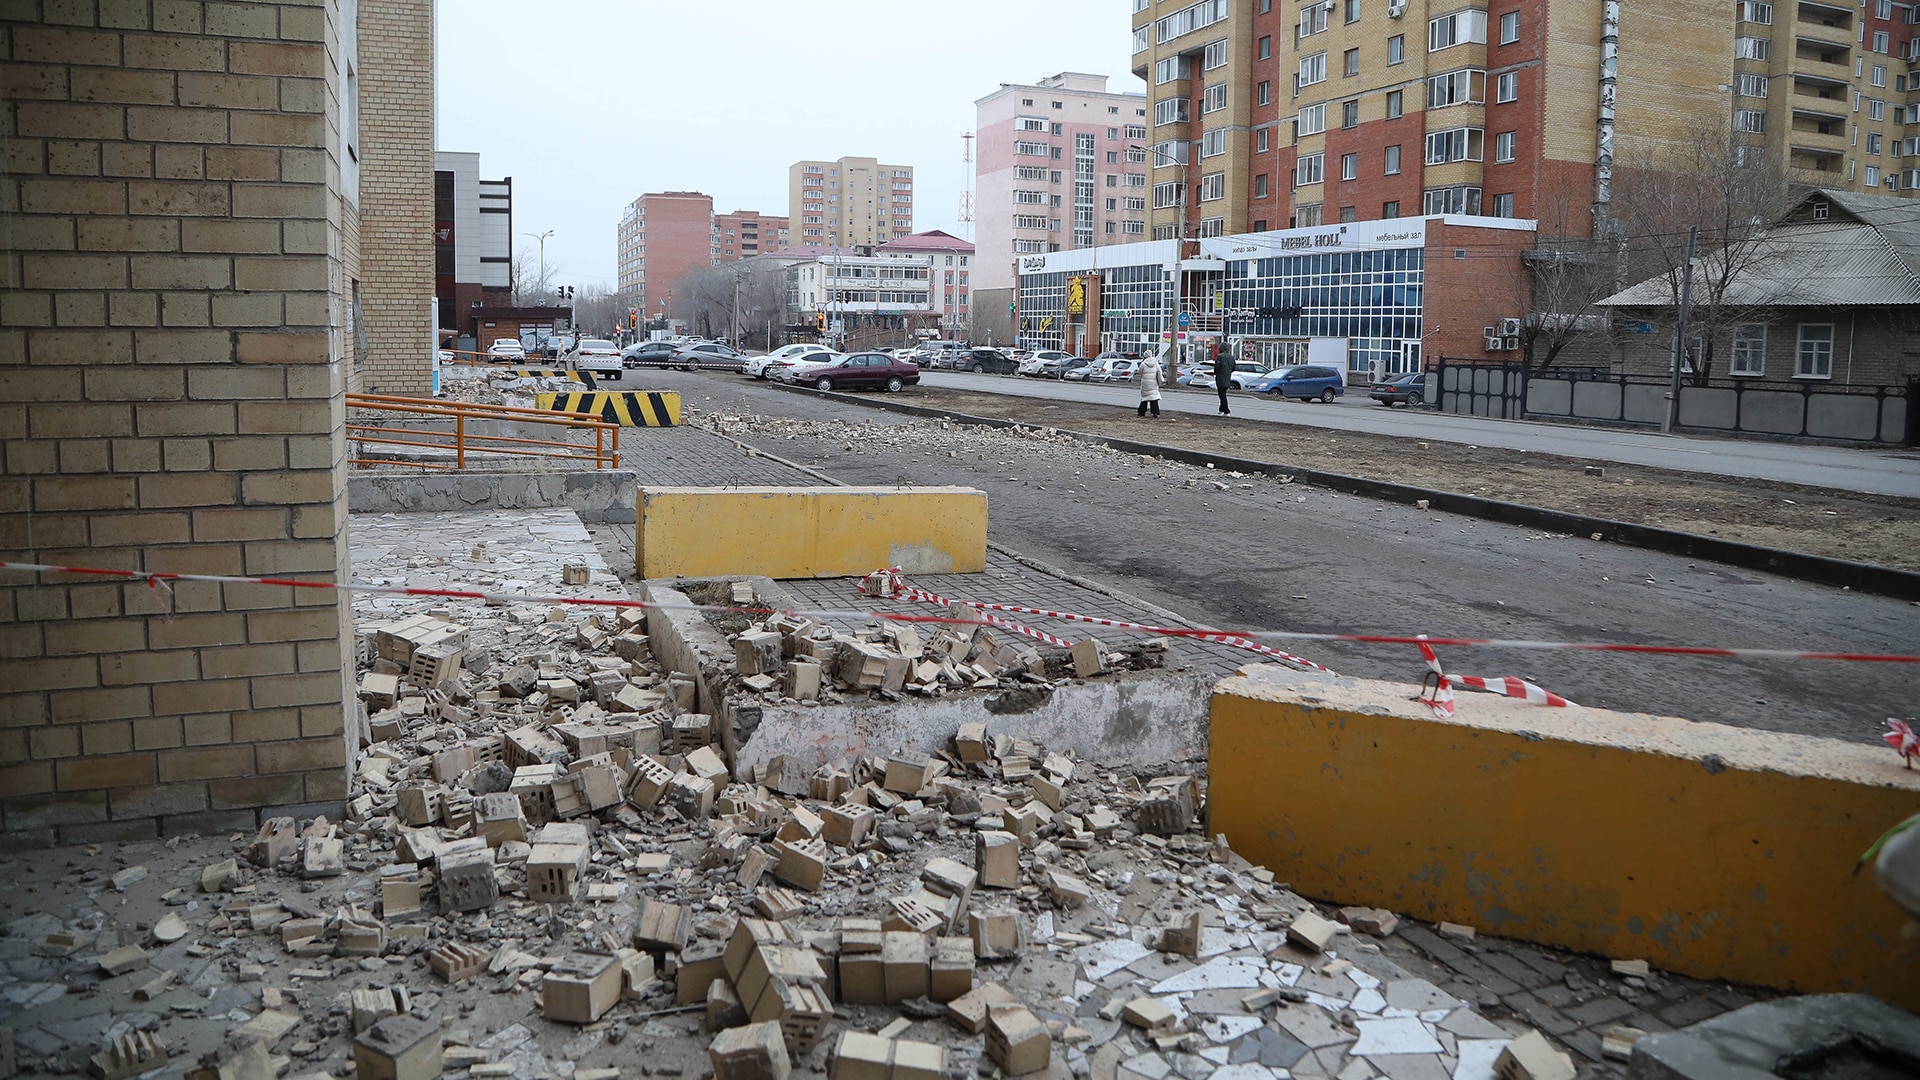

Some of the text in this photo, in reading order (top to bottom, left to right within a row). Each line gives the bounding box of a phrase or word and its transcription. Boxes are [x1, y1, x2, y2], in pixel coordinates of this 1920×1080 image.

[1281, 232, 1341, 250] MEBEL HOLL
[1376, 231, 1422, 242] мебельный зал
